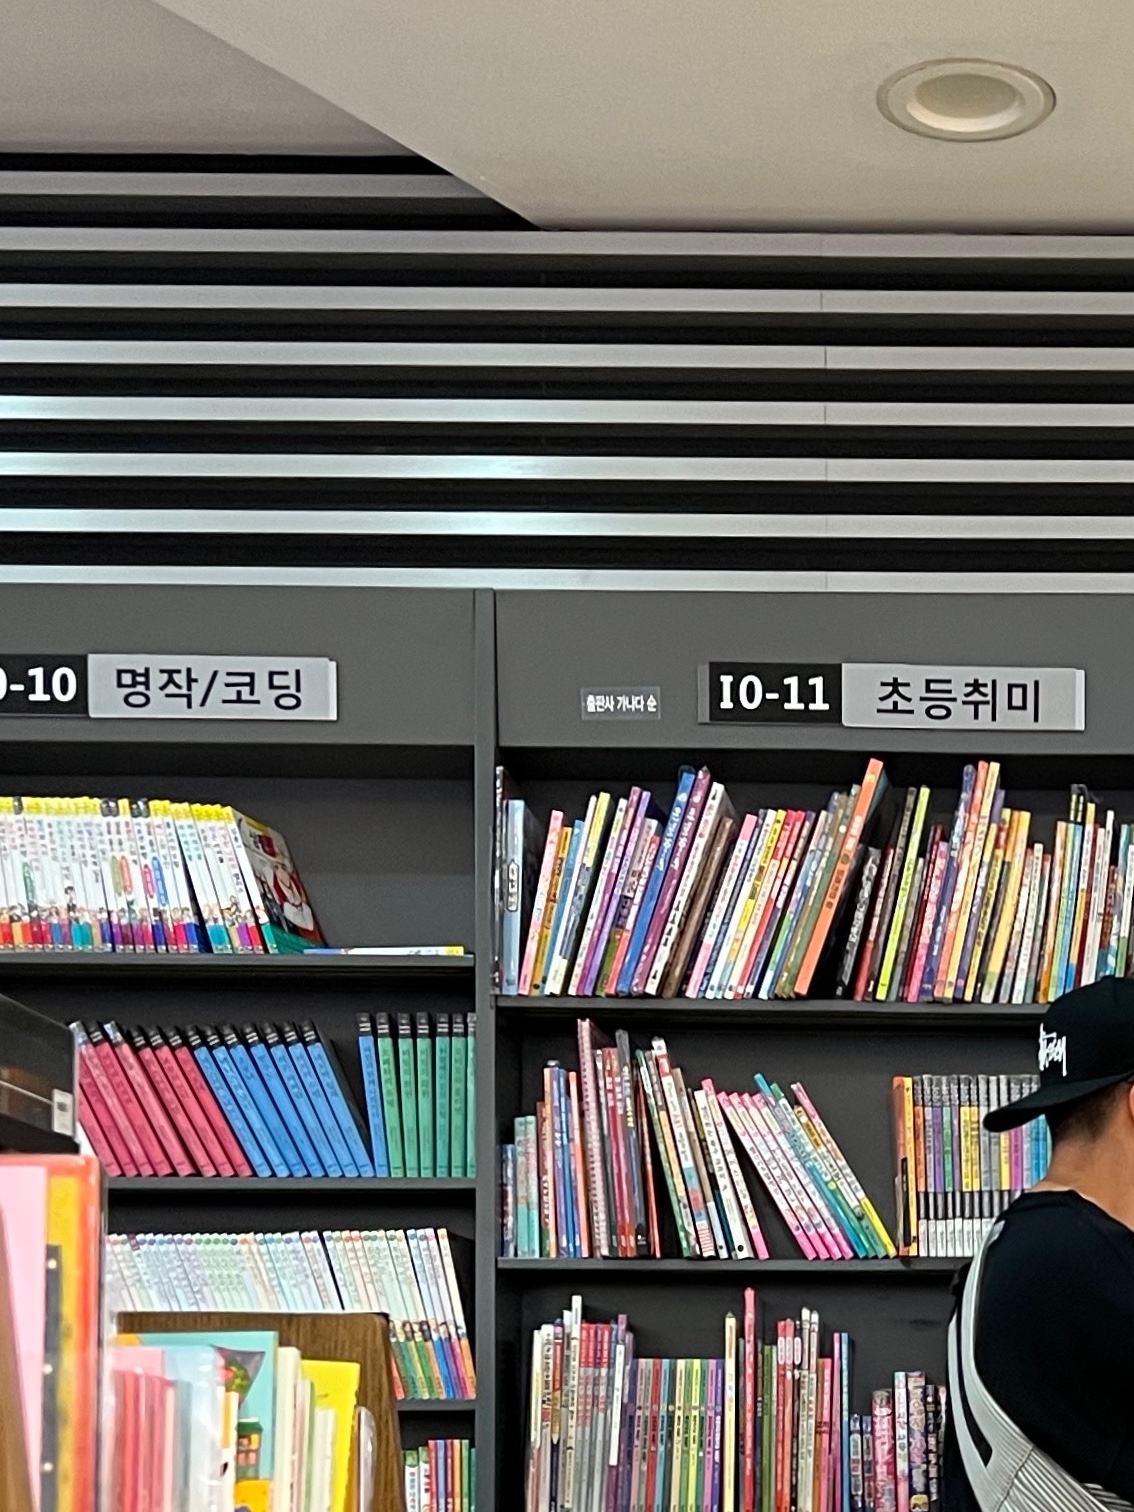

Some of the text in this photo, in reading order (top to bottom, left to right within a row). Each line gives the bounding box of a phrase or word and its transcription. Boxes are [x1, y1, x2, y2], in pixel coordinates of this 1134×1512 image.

[0, 666, 303, 710] -10 명작/코딩
[586, 694, 657, 713] 출판사 가나다 순
[875, 677, 1042, 722] 초등취미
